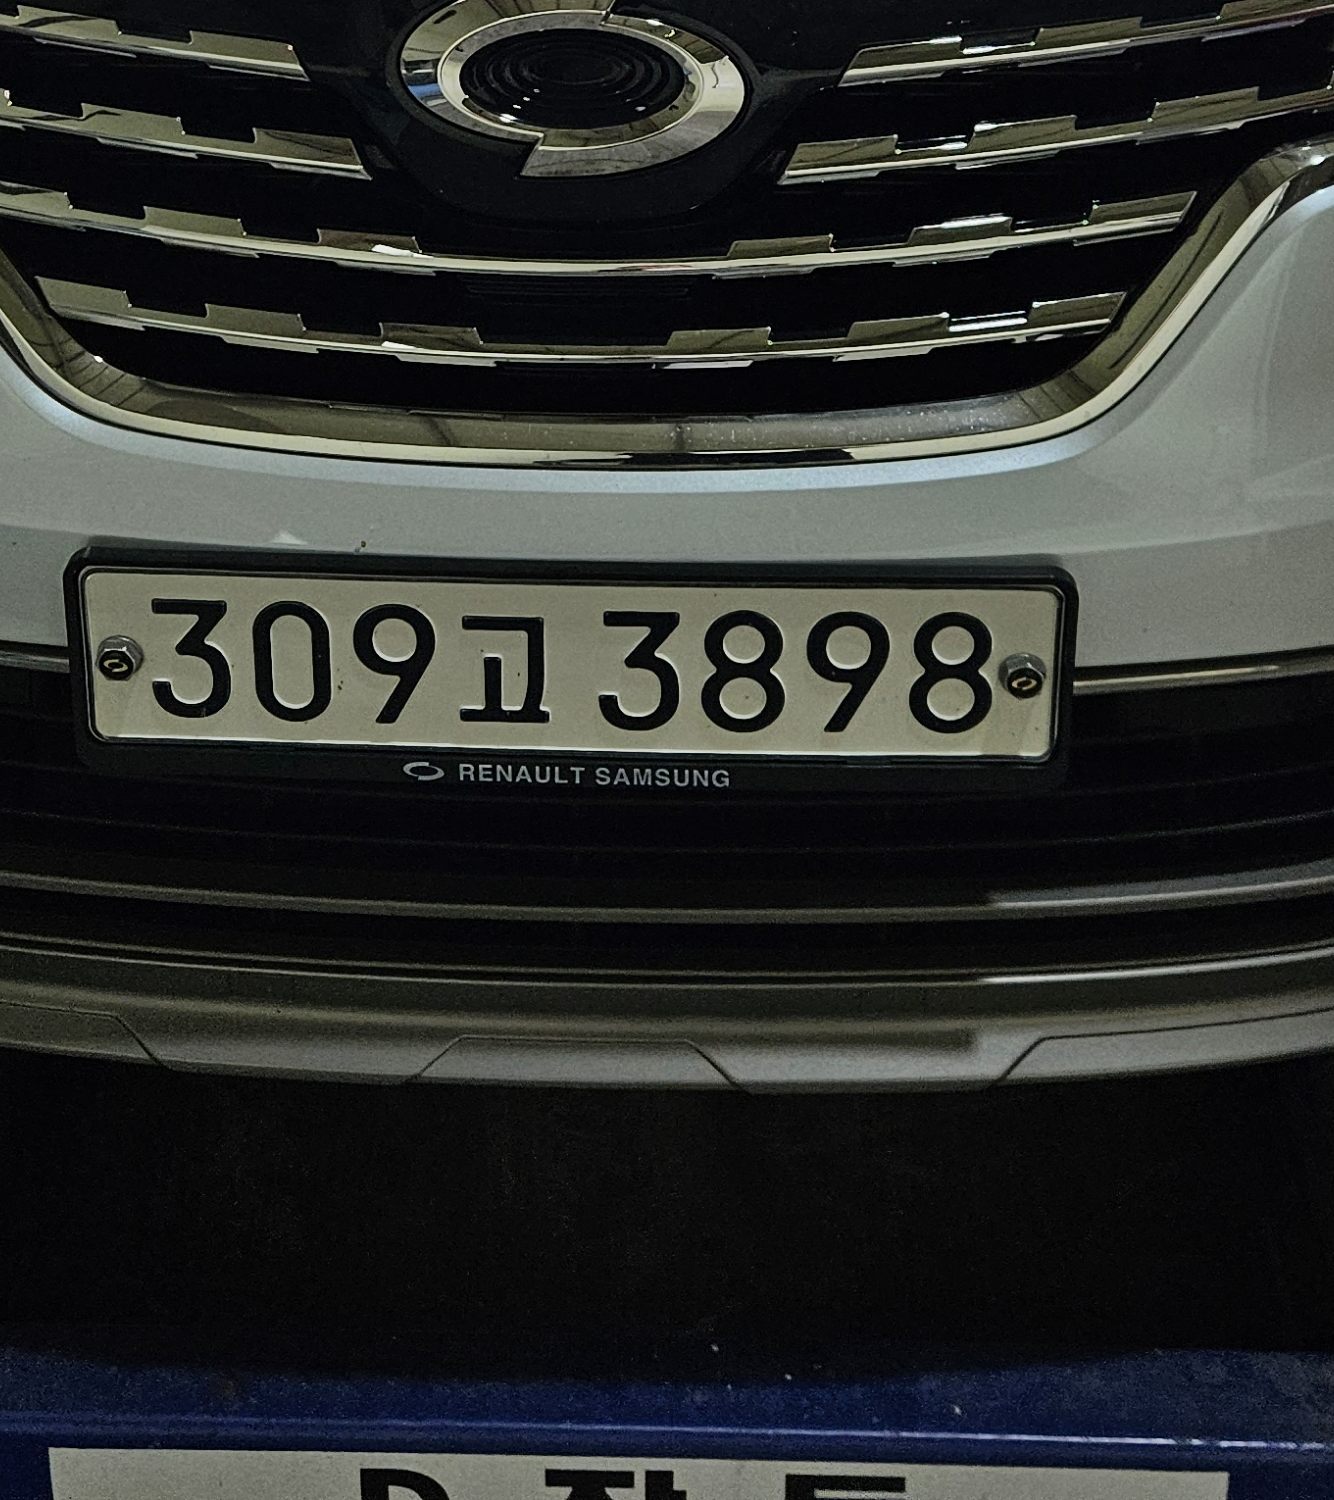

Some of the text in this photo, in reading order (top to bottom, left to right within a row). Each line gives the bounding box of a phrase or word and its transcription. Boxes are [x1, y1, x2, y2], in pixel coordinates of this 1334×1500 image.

[151, 597, 993, 734] 309고 3898
[459, 763, 730, 788] RENAULT SAMSUNG
